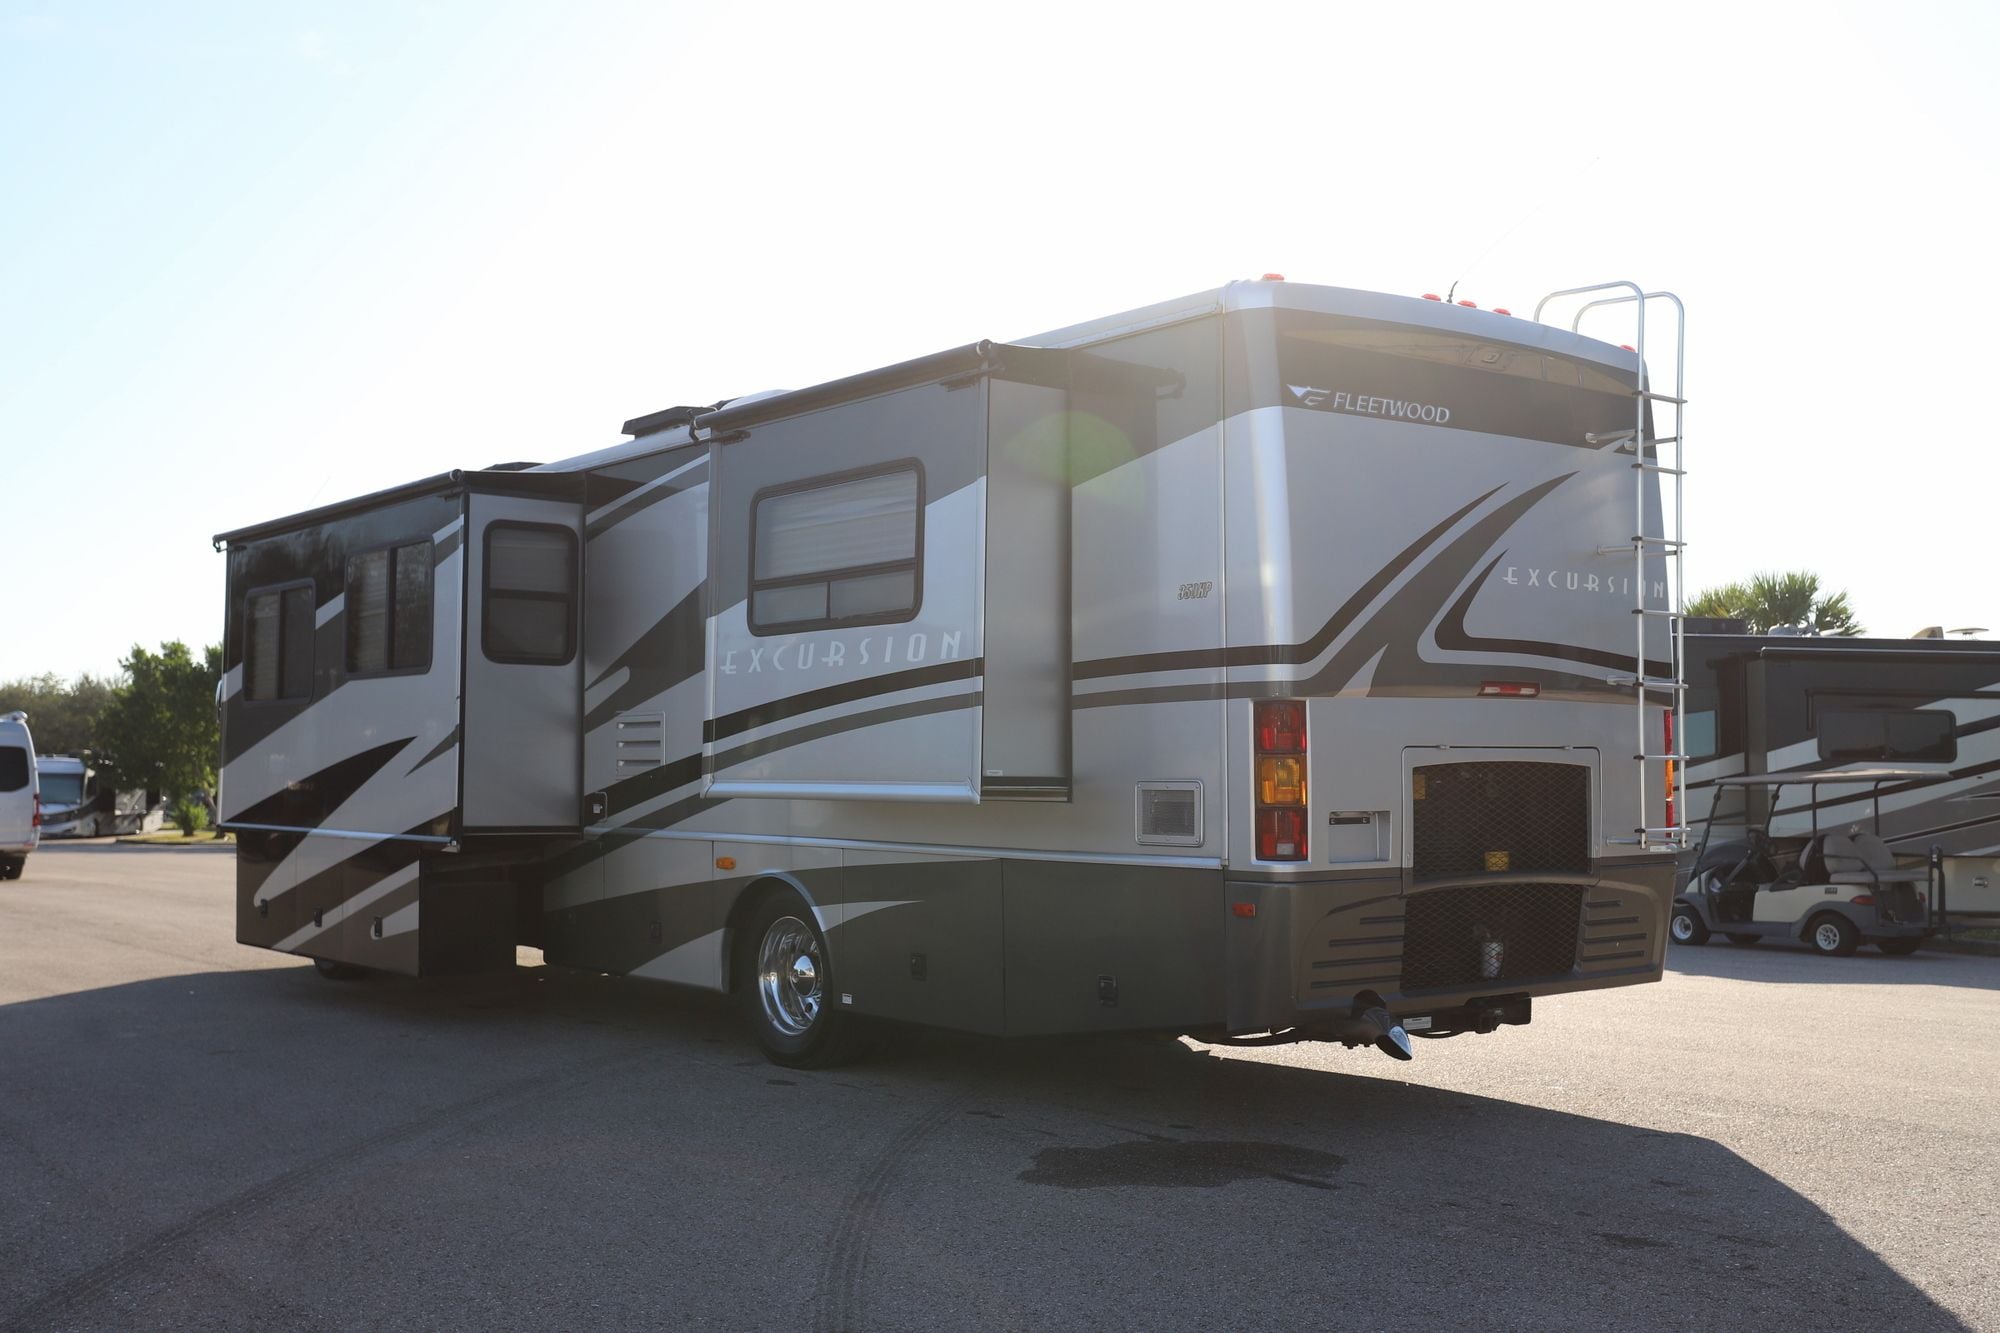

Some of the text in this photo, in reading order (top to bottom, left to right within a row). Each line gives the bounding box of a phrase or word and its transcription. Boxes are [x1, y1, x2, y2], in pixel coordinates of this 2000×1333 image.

[1333, 392, 1450, 423] FLEETWOOD
[1502, 567, 1664, 598] EXCURSIN
[720, 630, 961, 674] EXCURSION
